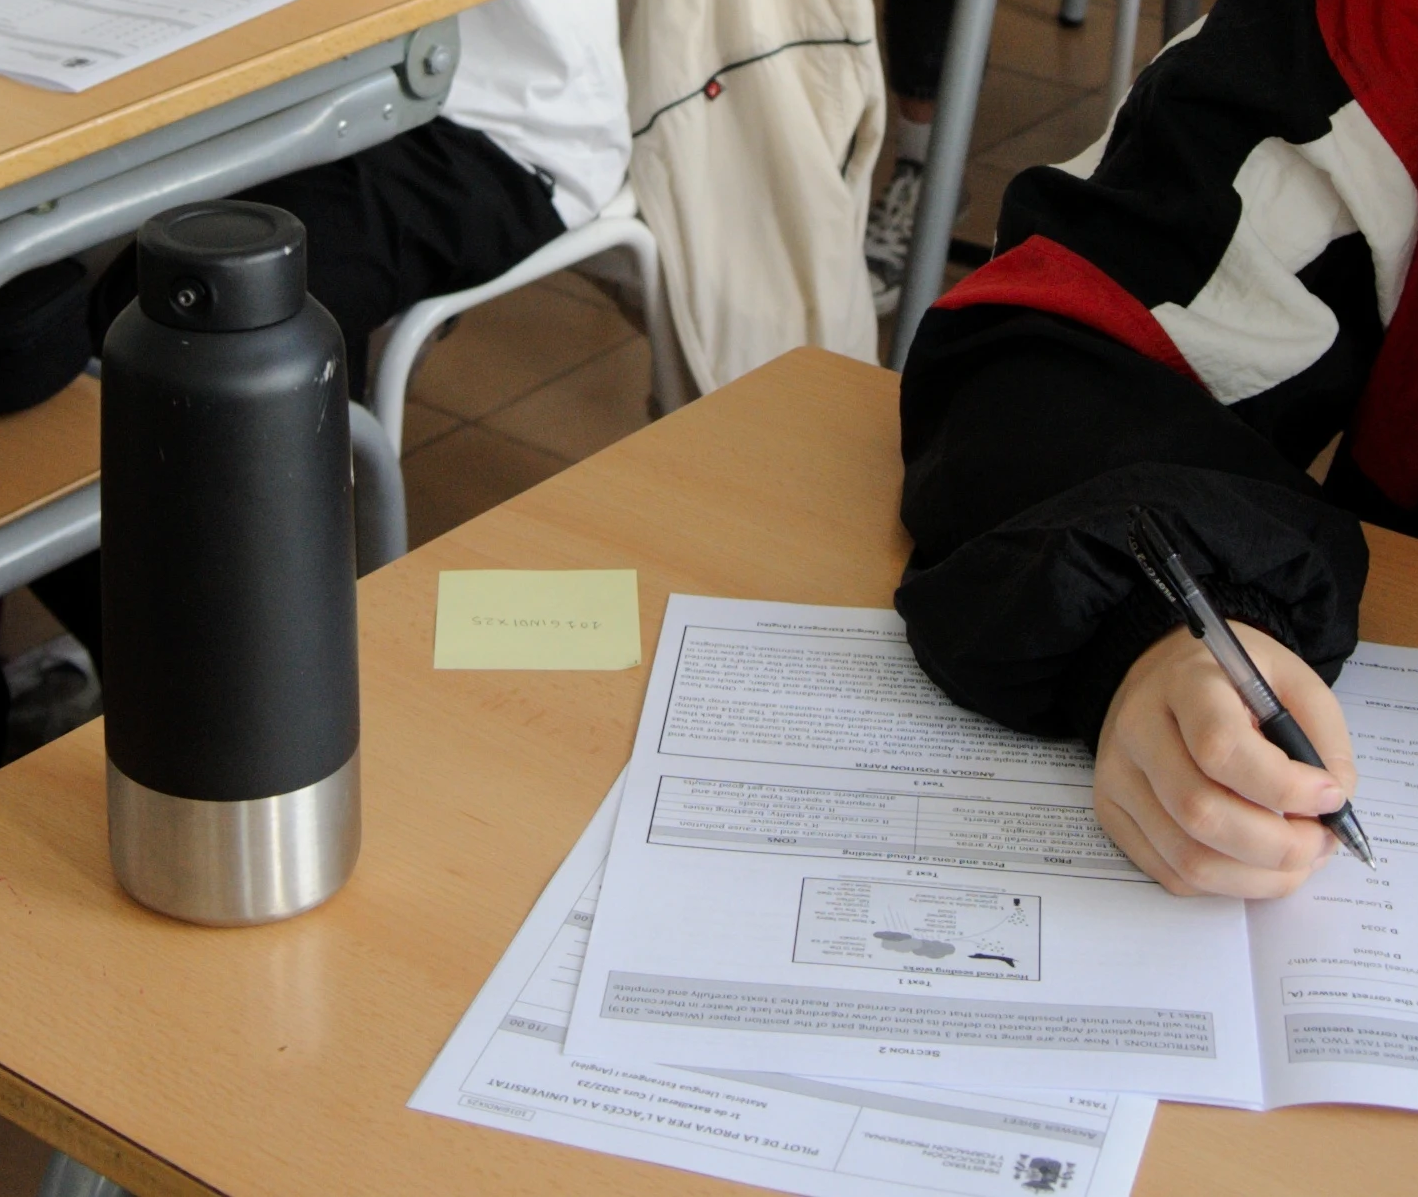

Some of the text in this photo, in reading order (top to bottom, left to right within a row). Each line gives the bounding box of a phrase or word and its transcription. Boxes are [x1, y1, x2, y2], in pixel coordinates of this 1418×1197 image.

[856, 763, 996, 778] ANGOLA'S POSITION PAPER
[982, 859, 1006, 868] Pros
[1044, 856, 1073, 865] PROS
[916, 871, 938, 879] Text
[1313, 896, 1353, 904] women
[1355, 900, 1383, 909] Local
[1353, 948, 1391, 959] Poland
[908, 979, 931, 988] Text
[613, 984, 666, 995] complete
[614, 994, 658, 1005] country
[691, 991, 739, 1000] carefully
[741, 995, 769, 1004] texts
[660, 1000, 686, 1008] their
[702, 1003, 734, 1011] water
[781, 998, 799, 1007] the
[802, 1000, 830, 1008] Read
[609, 1004, 640, 1015] 2019)
[750, 1006, 772, 1015] lack
[775, 1008, 793, 1016] the
[857, 1004, 897, 1012] carried
[916, 1008, 947, 1016] could
[709, 1014, 741, 1022] paper
[796, 1008, 849, 1019] regarding
[852, 1014, 878, 1022] view
[745, 1017, 790, 1026] position
[895, 1017, 924, 1025] point
[927, 1019, 940, 1027] its
[1017, 1015, 1064, 1023] possible
[1135, 1019, 1160, 1028] help
[794, 1020, 812, 1028] the
[942, 1021, 982, 1030] defend
[999, 1024, 1043, 1032] created
[1185, 1023, 1206, 1032] This
[859, 1024, 910, 1036] including
[913, 1029, 941, 1037] texts
[1045, 1026, 1084, 1034] Angola
[1101, 1029, 1161, 1038] delegation
[1001, 1033, 1033, 1042] going
[1164, 1032, 1182, 1040] the
[1185, 1034, 1209, 1042] that
[1084, 1038, 1110, 1046] Now
[1124, 1040, 1209, 1053] INSTRUCTIONS
[571, 1060, 614, 1076] (Anglès)
[622, 1072, 677, 1090] Estrangera
[488, 1079, 569, 1103] UNIVERSITAT
[577, 1080, 622, 1095] 2022/23
[679, 1085, 720, 1099] Llengua
[623, 1089, 647, 1100] Curs
[1078, 1099, 1107, 1111] TASK
[602, 1104, 654, 1121] L'ACCÉS
[668, 1118, 693, 1130] PER
[696, 1124, 741, 1140] PROVA
[783, 1143, 820, 1156] PILOT
